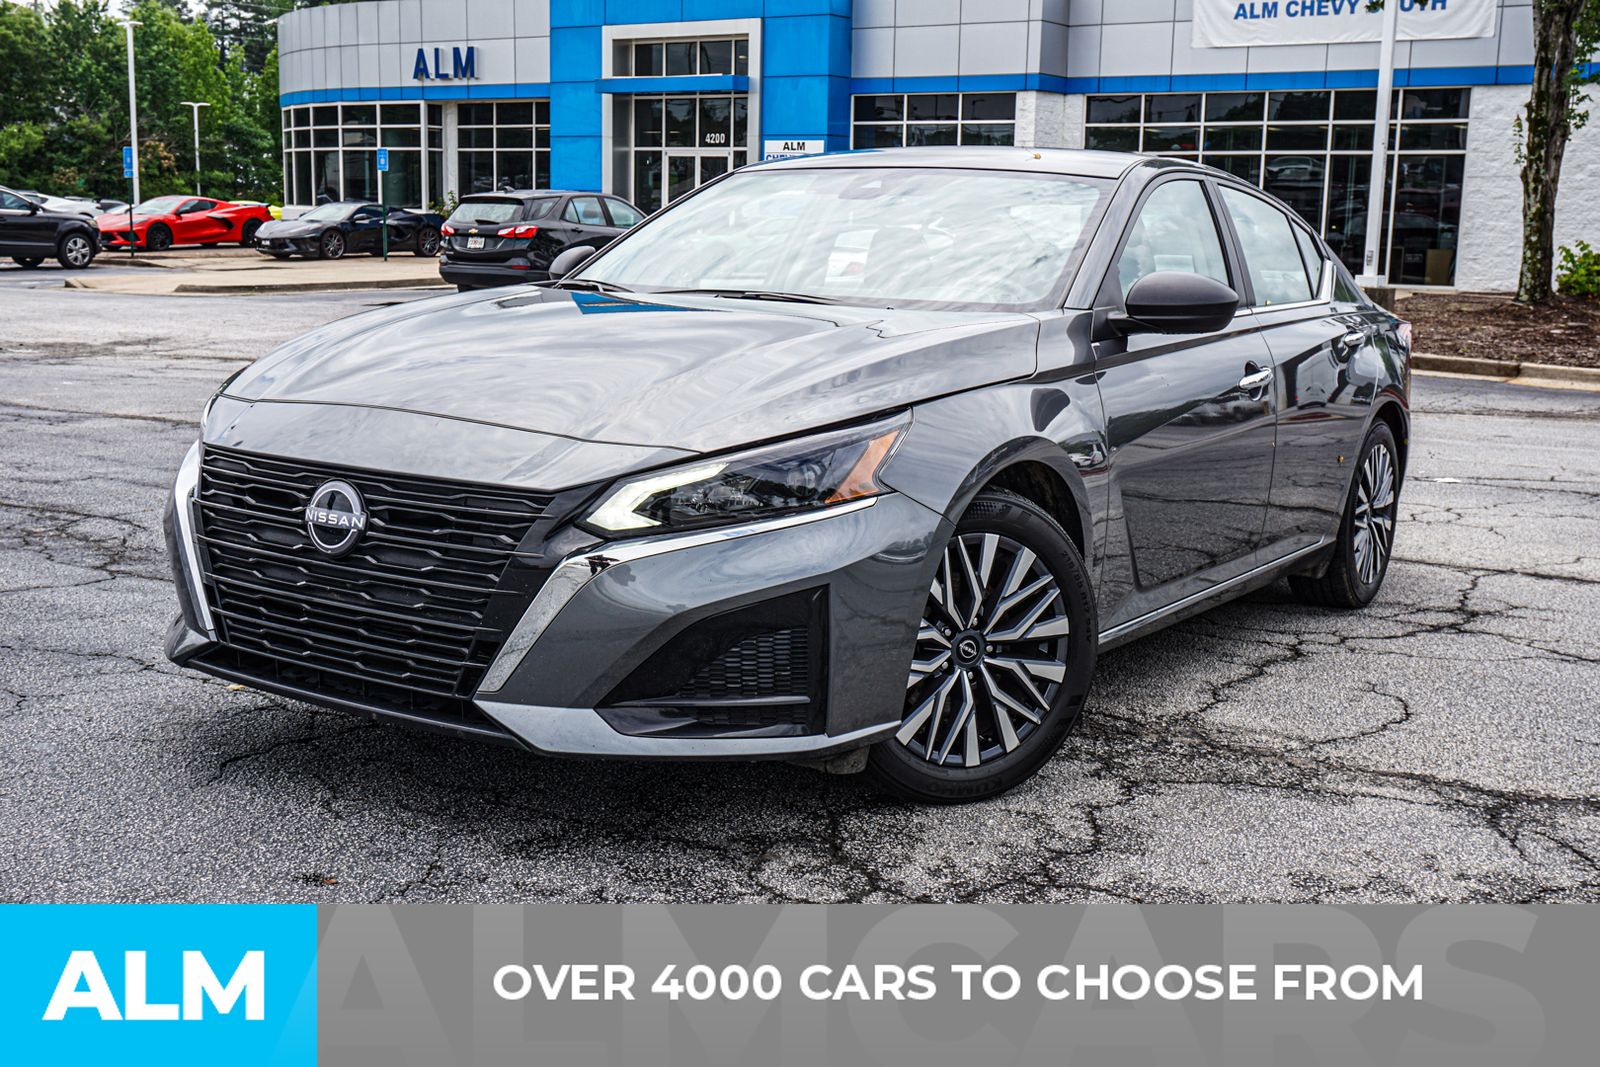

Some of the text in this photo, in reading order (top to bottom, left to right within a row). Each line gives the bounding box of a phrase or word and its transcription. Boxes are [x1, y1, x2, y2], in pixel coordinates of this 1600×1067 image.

[1233, 1, 1278, 20] ALM
[1285, 0, 1359, 17] CHEVY
[413, 47, 475, 79] ALM
[705, 133, 726, 144] 4200
[783, 141, 805, 151] ALM
[305, 508, 364, 528] NISSAN
